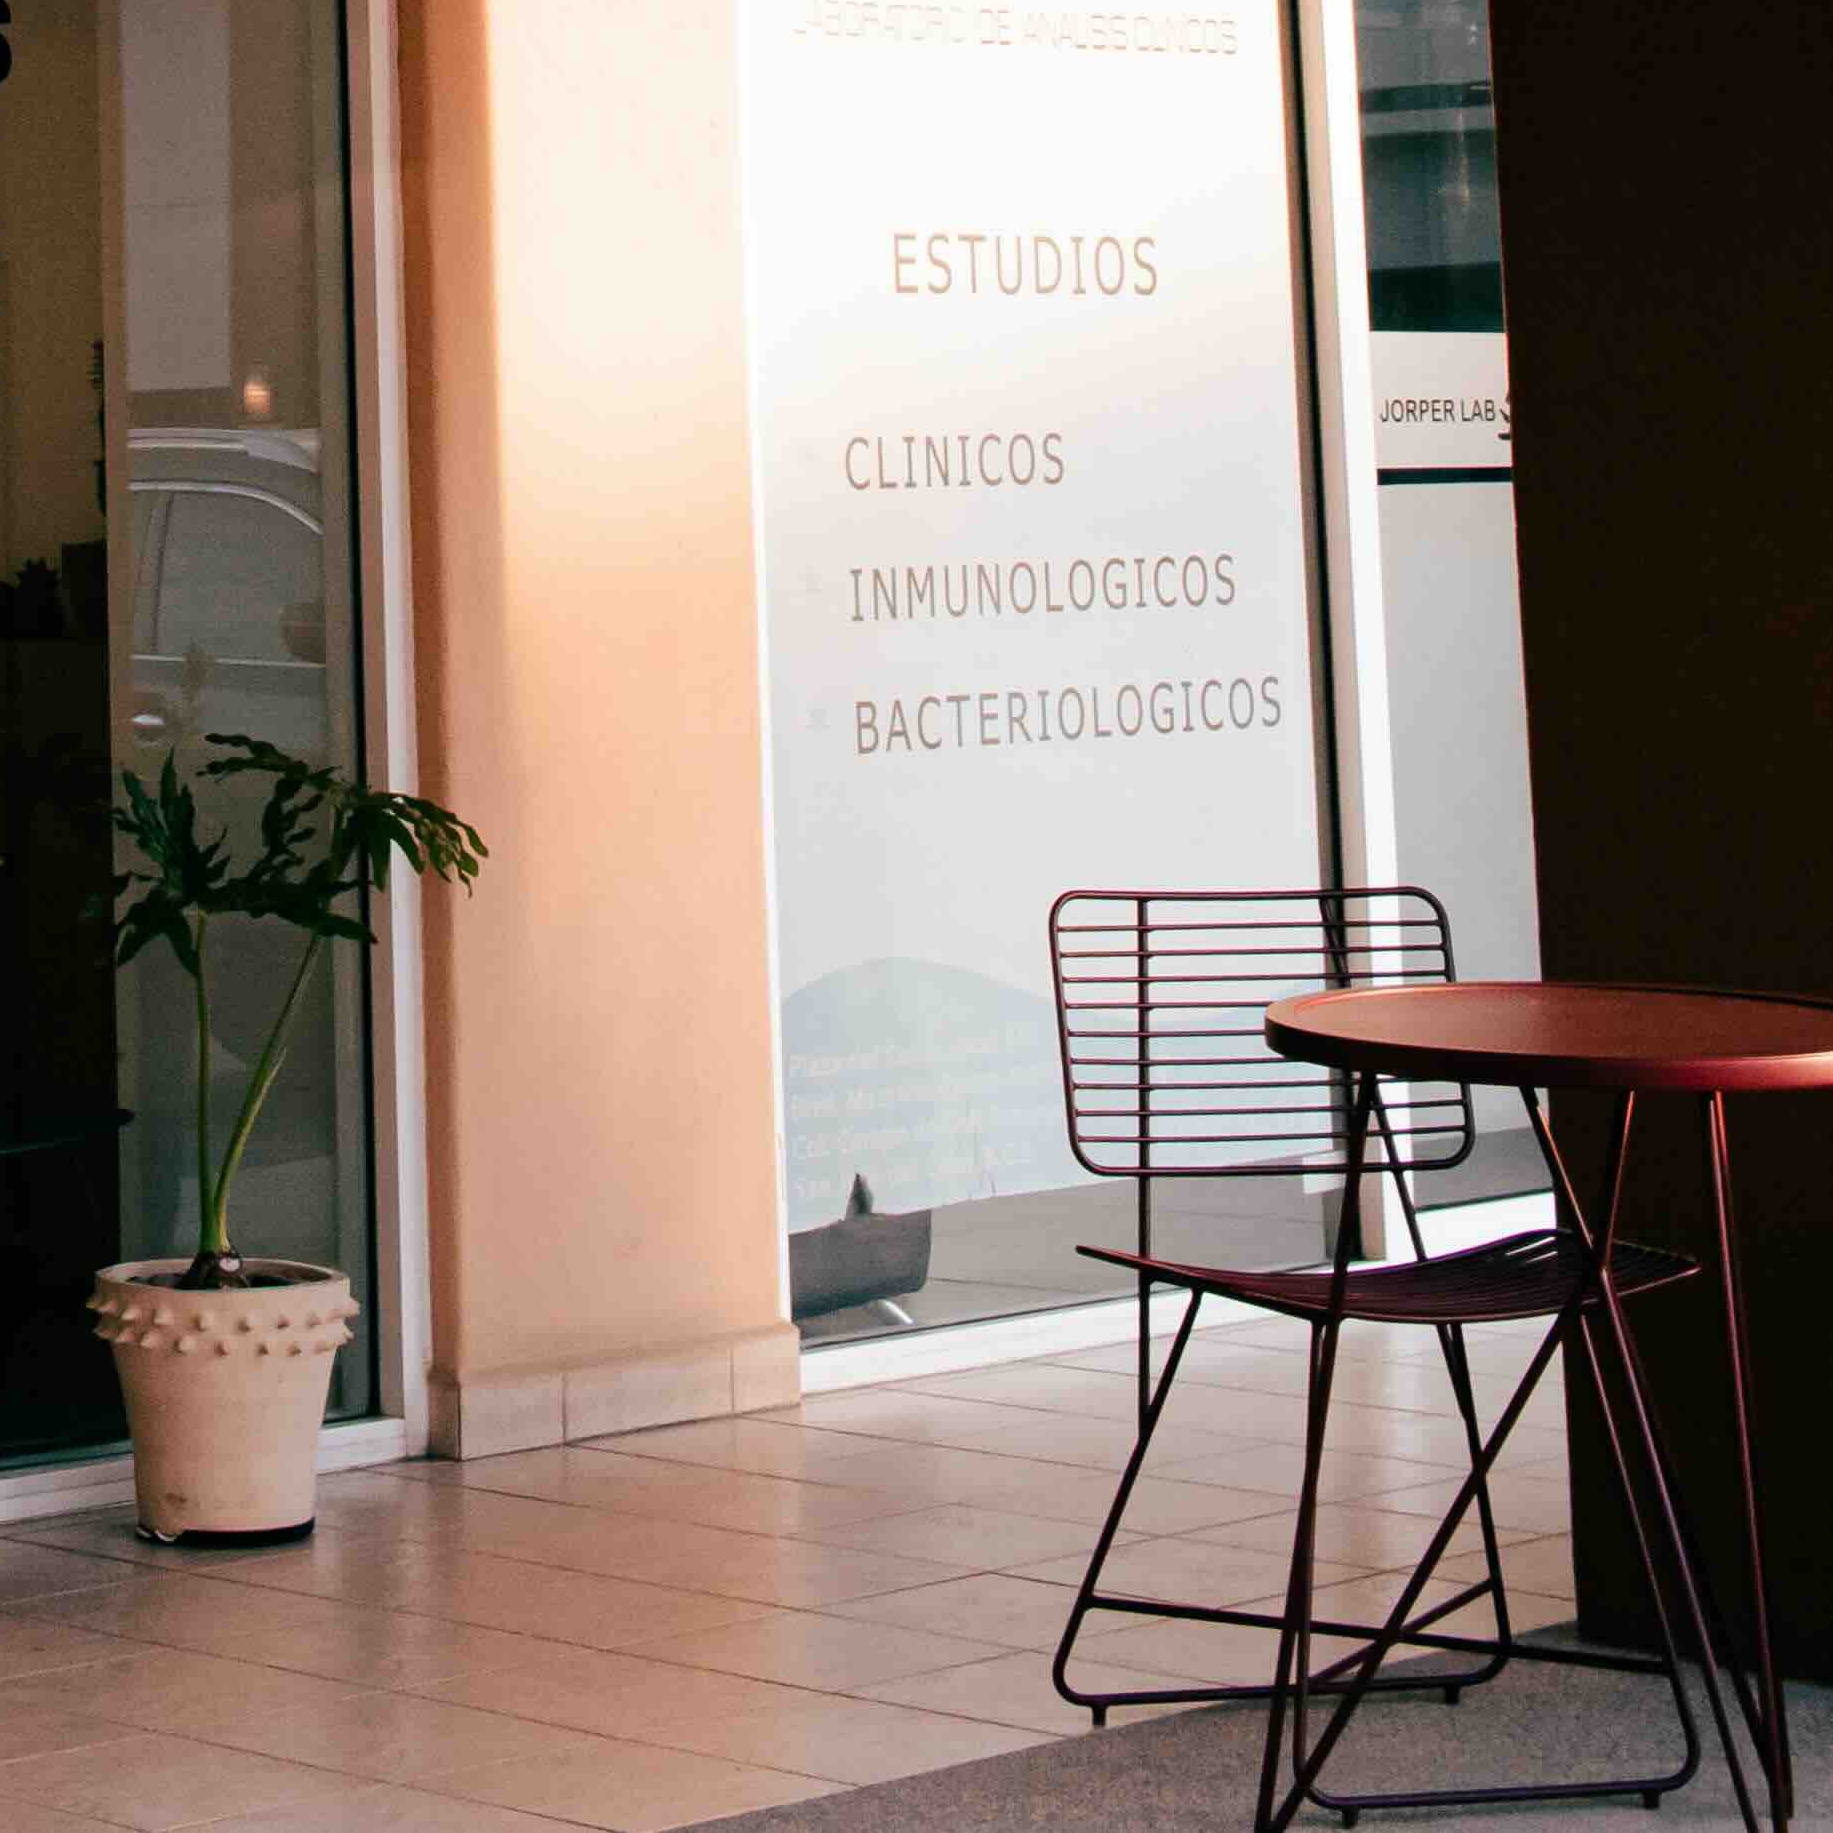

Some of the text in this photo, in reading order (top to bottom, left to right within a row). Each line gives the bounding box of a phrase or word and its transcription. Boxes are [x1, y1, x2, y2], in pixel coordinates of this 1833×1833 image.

[892, 233, 1159, 297] ESTUDIOS
[1379, 398, 1496, 423] JORPER LAB
[844, 433, 1065, 491] CLINICOS
[850, 554, 1237, 623] INMUNOLOGICOS
[856, 675, 1283, 755] BACTERIOLOGICOS
